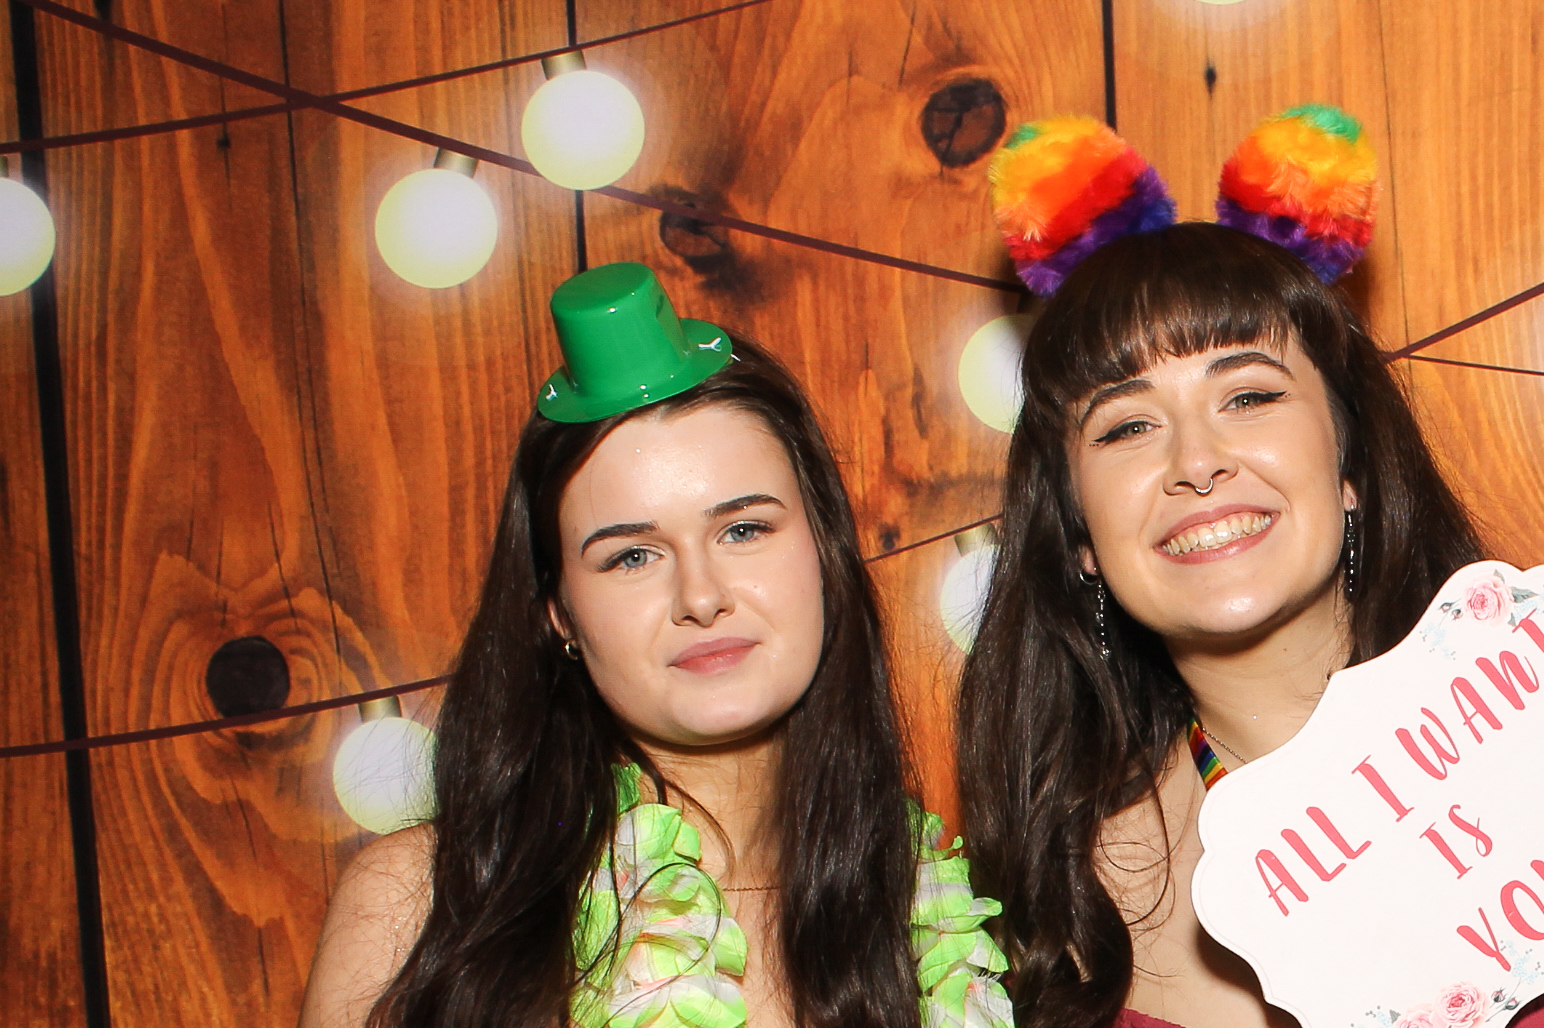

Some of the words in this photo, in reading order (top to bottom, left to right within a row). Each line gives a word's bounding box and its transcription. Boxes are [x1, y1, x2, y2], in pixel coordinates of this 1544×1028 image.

[1254, 806, 1372, 917] ALL
[1351, 754, 1414, 822] I
[1419, 804, 1493, 879] IS
